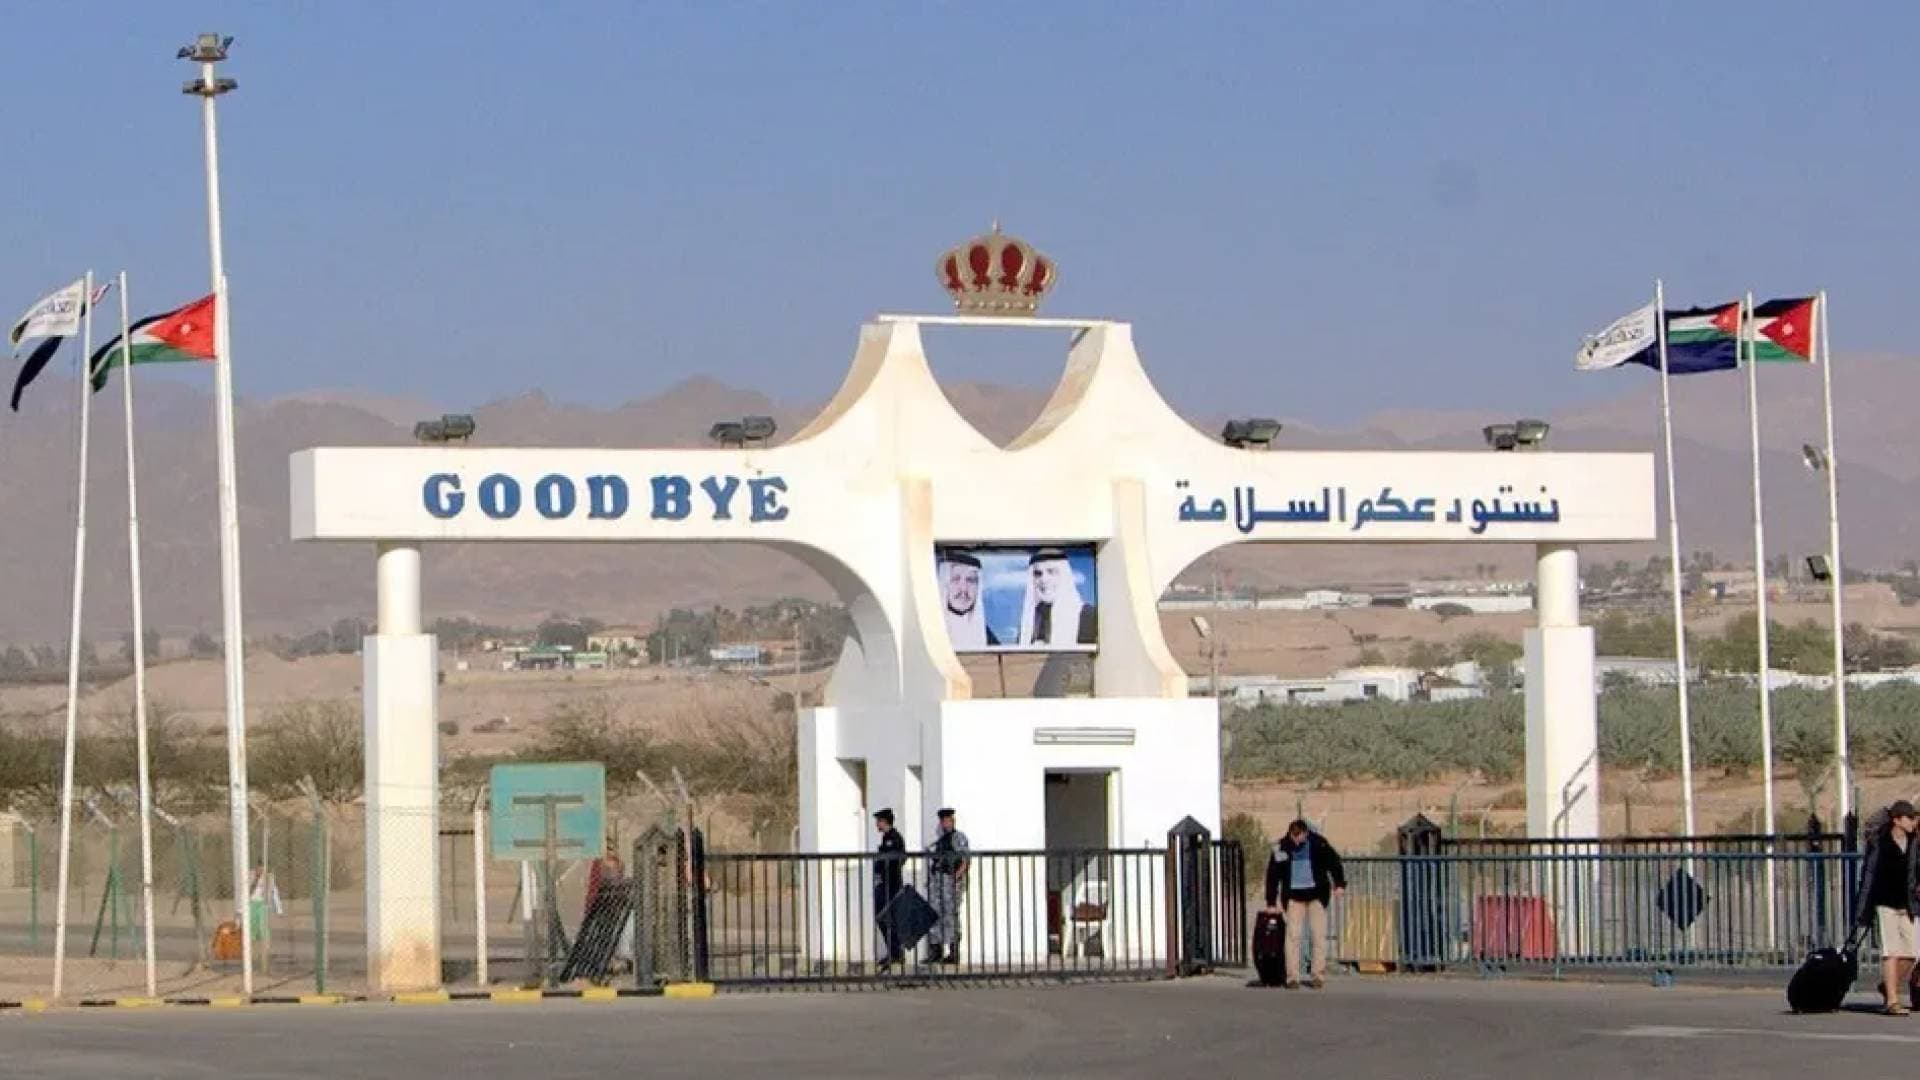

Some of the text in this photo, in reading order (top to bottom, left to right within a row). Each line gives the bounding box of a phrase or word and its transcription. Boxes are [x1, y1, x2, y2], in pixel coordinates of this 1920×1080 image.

[422, 472, 790, 523] GOOD BYE
[1175, 479, 1347, 534] السلامة
